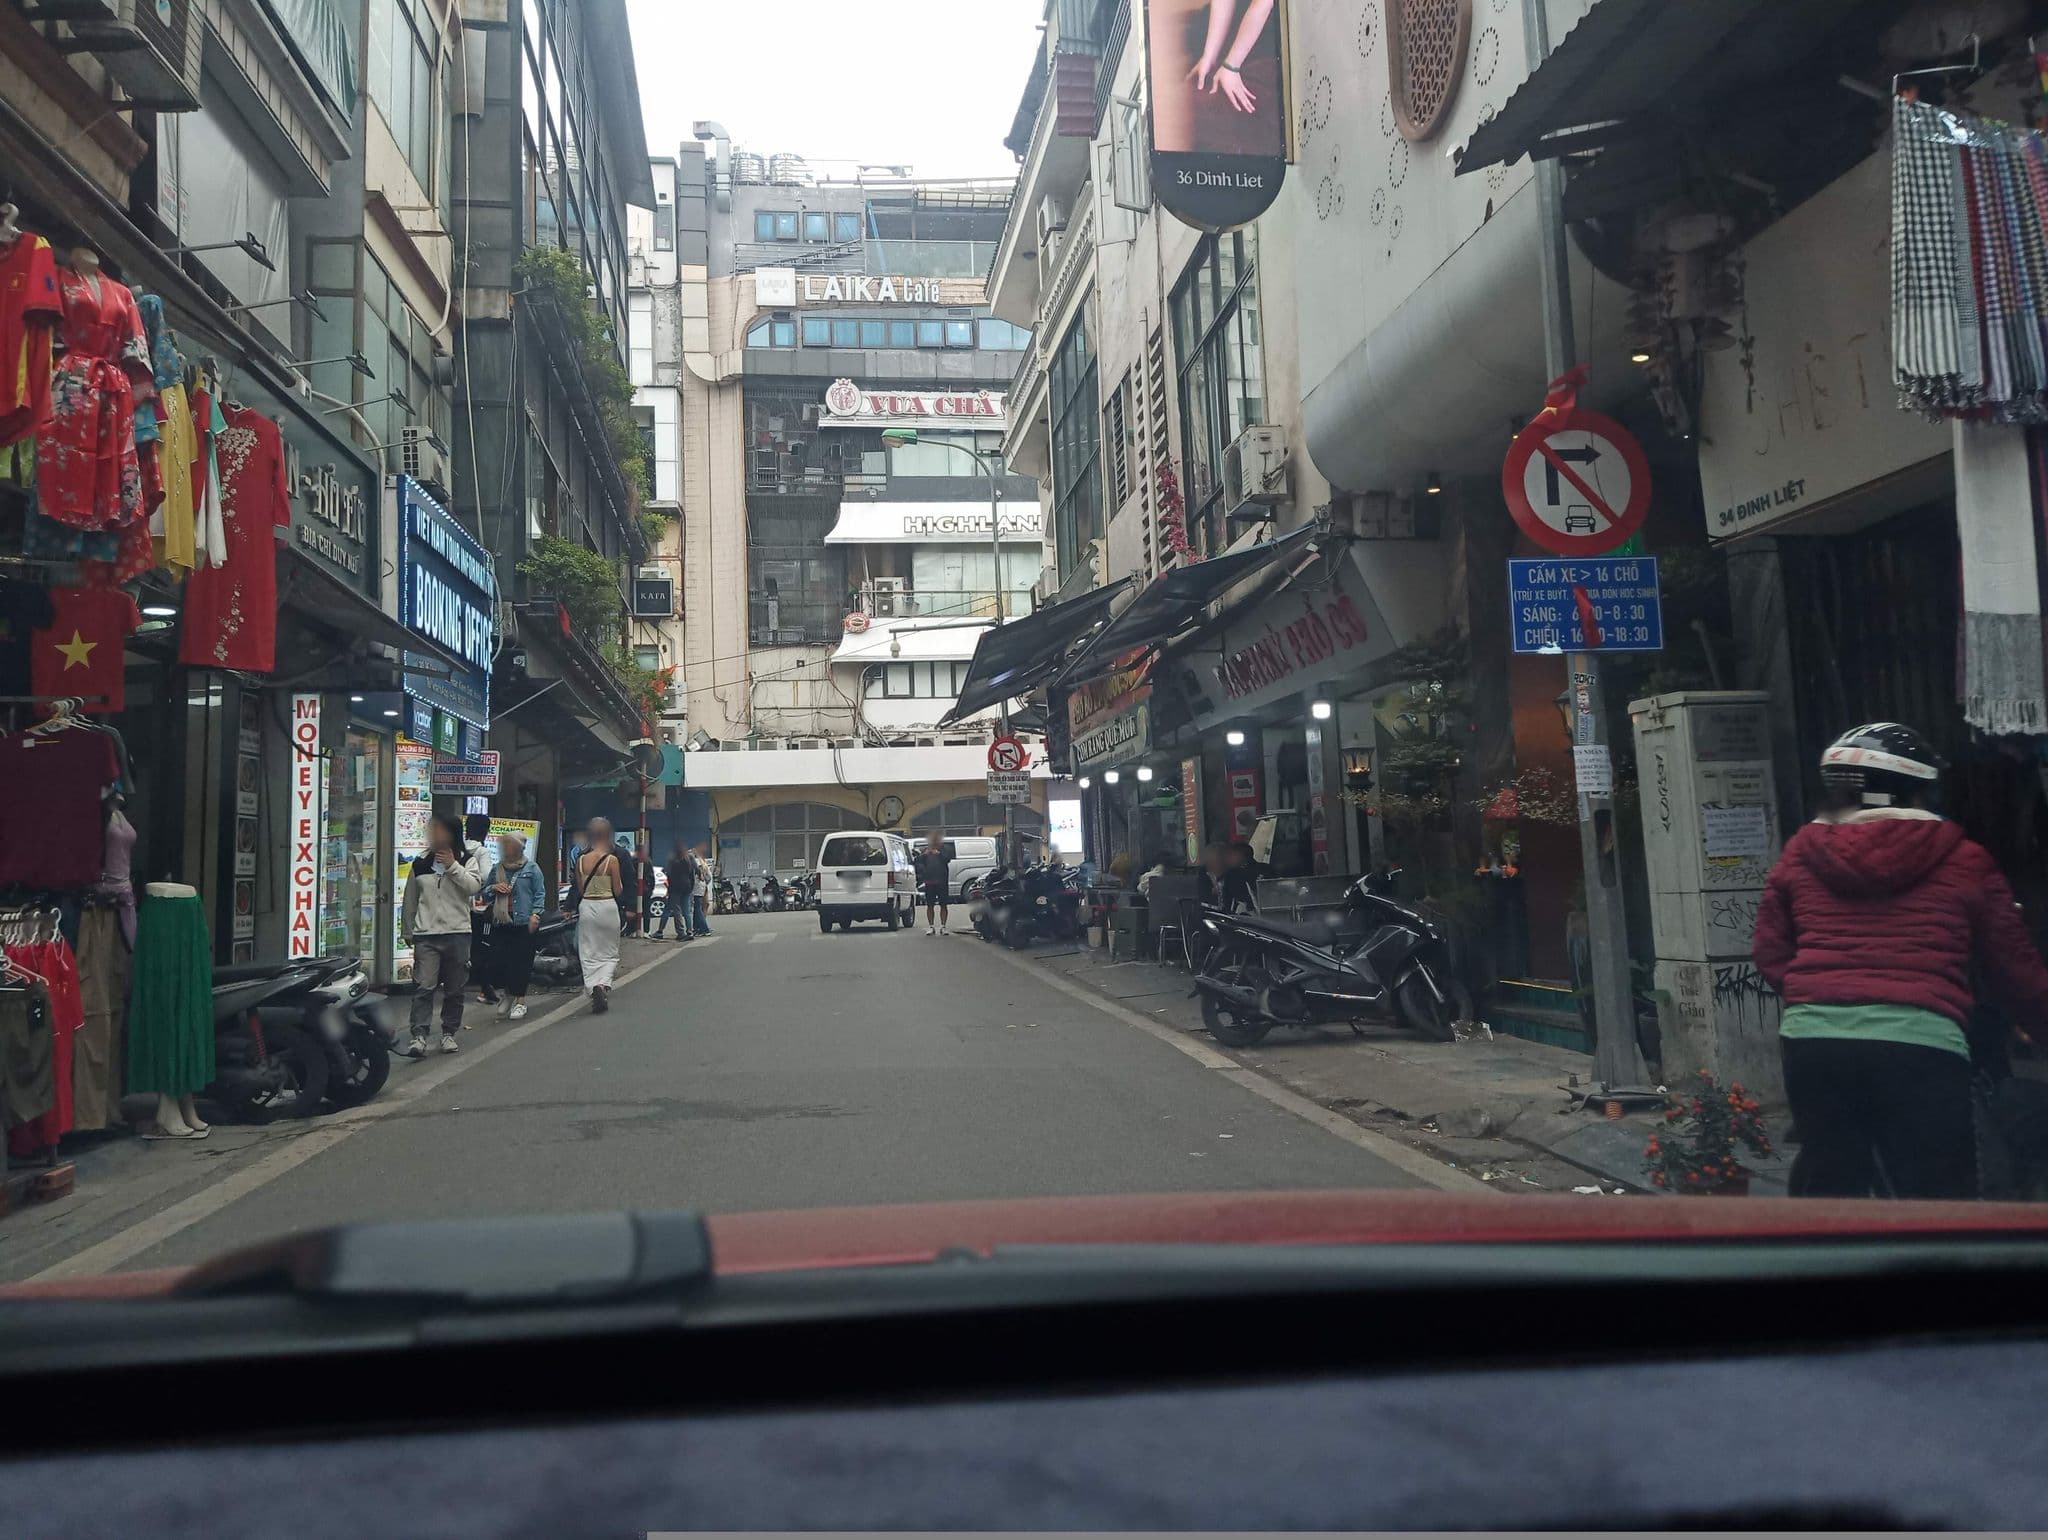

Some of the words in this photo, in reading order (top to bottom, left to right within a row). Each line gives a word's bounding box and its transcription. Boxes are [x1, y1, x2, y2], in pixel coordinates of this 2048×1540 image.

[1176, 170, 1193, 185] 36
[1196, 171, 1232, 186] Dinh
[1235, 172, 1263, 188] Liet
[804, 275, 898, 302] LAIKA
[903, 276, 940, 303] Café
[867, 395, 928, 416] VUA
[934, 389, 999, 417] CHẢ
[1718, 508, 1734, 527] 34
[1737, 494, 1771, 520] ĐINH
[1774, 478, 1805, 506] LIỆT
[416, 505, 430, 544] VIET
[904, 516, 1042, 534] HIGHLAN
[332, 544, 346, 567] DUY
[1528, 563, 1555, 583] CẤM
[1561, 568, 1577, 583] XE
[1597, 567, 1608, 582] 16
[1615, 561, 1639, 582] CHỖ
[1535, 590, 1545, 600] XE
[416, 563, 461, 654] BOOKING
[465, 602, 493, 675] OFFICE
[1523, 603, 1562, 622] SÁNG:
[1524, 624, 1565, 645] CHIỀU:
[296, 699, 318, 810] MONEY
[459, 775, 495, 784] EXCHANGE
[466, 766, 495, 774] SERVICE
[292, 819, 314, 956] EXCHAN
